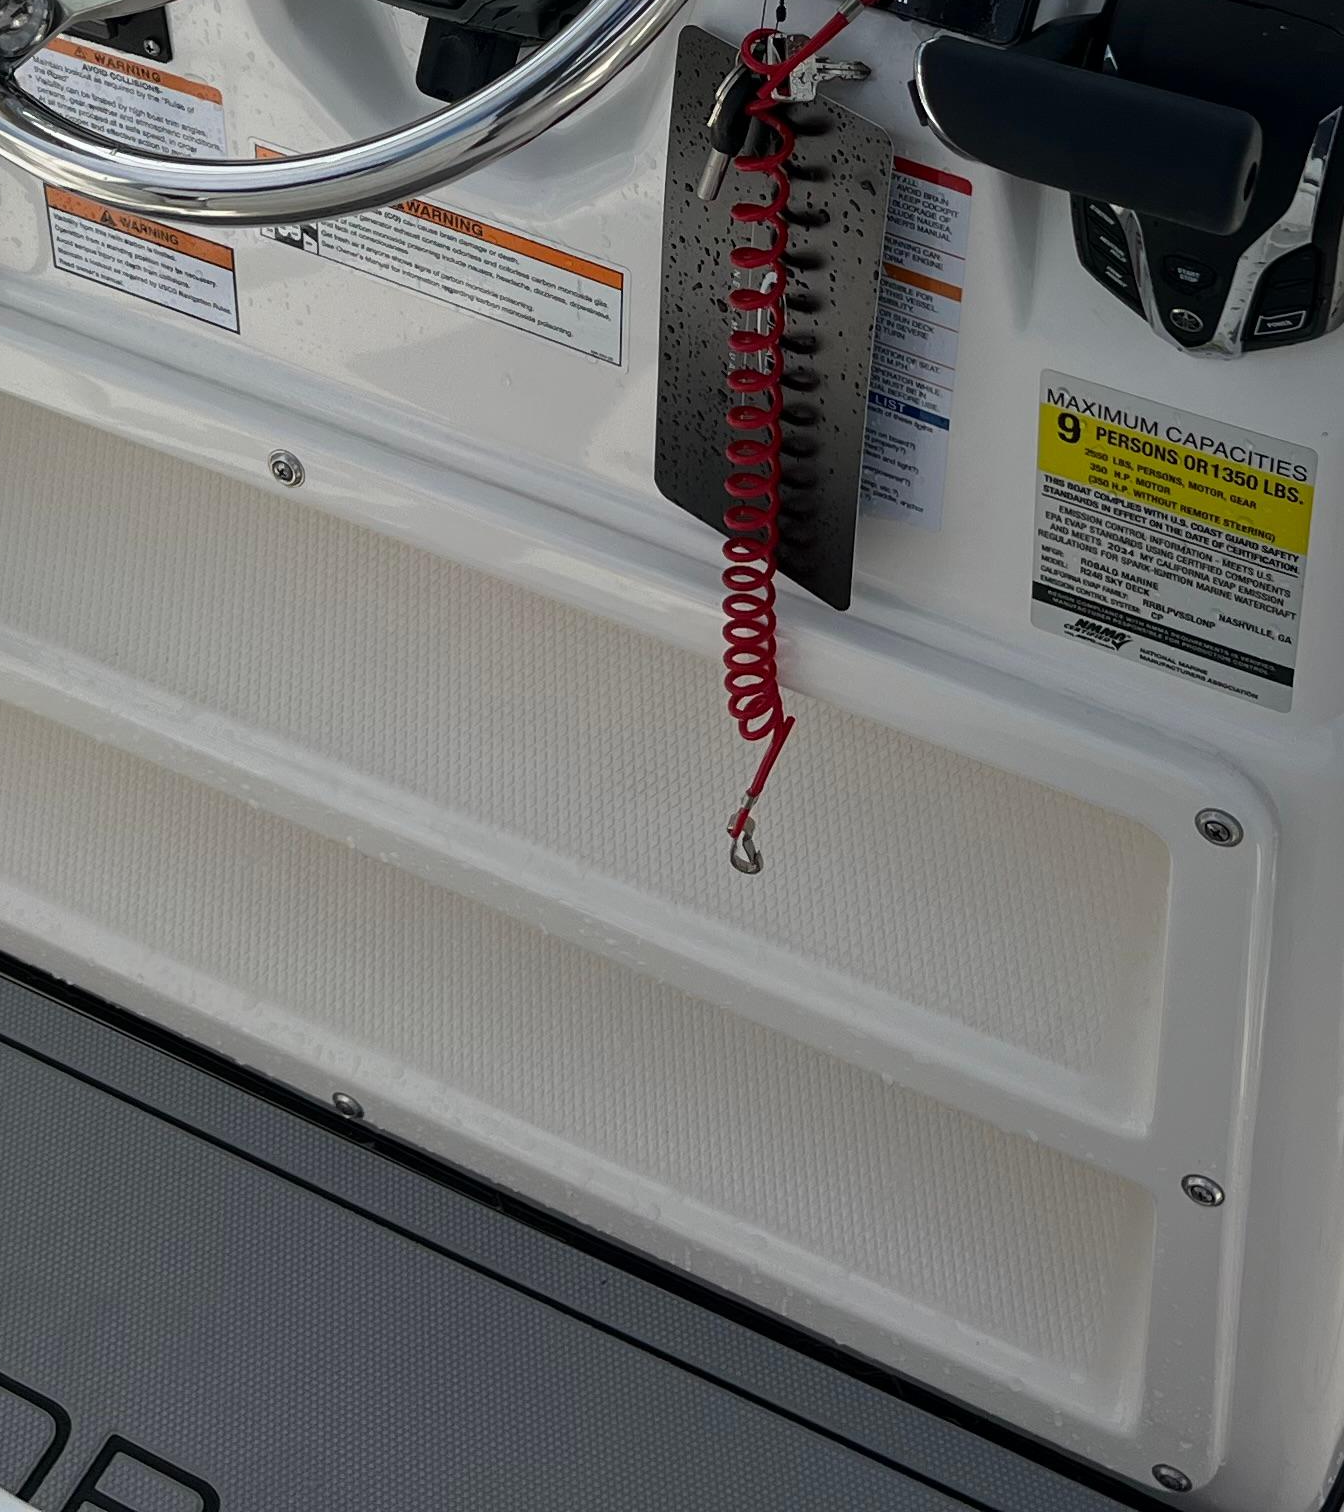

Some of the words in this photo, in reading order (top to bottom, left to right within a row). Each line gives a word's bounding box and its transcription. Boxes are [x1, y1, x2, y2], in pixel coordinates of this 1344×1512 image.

[82, 63, 108, 77] AVOID
[94, 53, 162, 83] WARNING
[120, 217, 179, 246] WARNING
[406, 200, 484, 237] WARNING
[875, 394, 907, 413] LIST
[1047, 388, 1158, 437] MAXIMUM
[1166, 426, 1307, 482] CAPACITIES
[1058, 412, 1081, 444] 9
[1096, 426, 1178, 465] PERSONS
[1184, 454, 1208, 475] OR
[1211, 464, 1258, 490] 1350
[1263, 479, 1304, 505] LBS.
[1090, 463, 1107, 474] 350
[1136, 477, 1170, 495] MOTOR
[1113, 457, 1133, 471] LBS,
[1137, 464, 1185, 488] PERSONS,
[1188, 481, 1226, 501] MOTOR,
[1230, 495, 1256, 509] GEAR
[1044, 474, 1064, 487] THIS
[1067, 482, 1091, 495] BOAT
[1094, 491, 1141, 513] COMPLIES
[1143, 507, 1168, 521] WITH
[1170, 516, 1188, 528] U.S.
[1190, 522, 1222, 539] COAST
[1225, 534, 1258, 551] GUARD
[1261, 545, 1299, 563] SAFETY
[1088, 475, 1109, 487] (350
[1133, 489, 1177, 510] WITHOUT
[1180, 504, 1219, 523] REMOTE
[1223, 518, 1275, 543] STEERING)
[1043, 484, 1098, 509] STANDARDS
[1101, 504, 1110, 513] IN
[1114, 508, 1146, 524] EFFECT
[1149, 519, 1162, 530] ON
[1165, 524, 1182, 537] THE
[1185, 531, 1207, 545] DATE
[1211, 540, 1223, 549] OF
[1226, 544, 1298, 574] CERTIFICATION.
[1080, 558, 1118, 577] ROBALO
[1121, 571, 1158, 591] MARINE
[1105, 575, 1123, 587] SKY
[1125, 582, 1150, 597] DECK
[1151, 612, 1163, 621] CP
[1218, 614, 1275, 640] NASHVILLE,
[1278, 634, 1292, 644] GA
